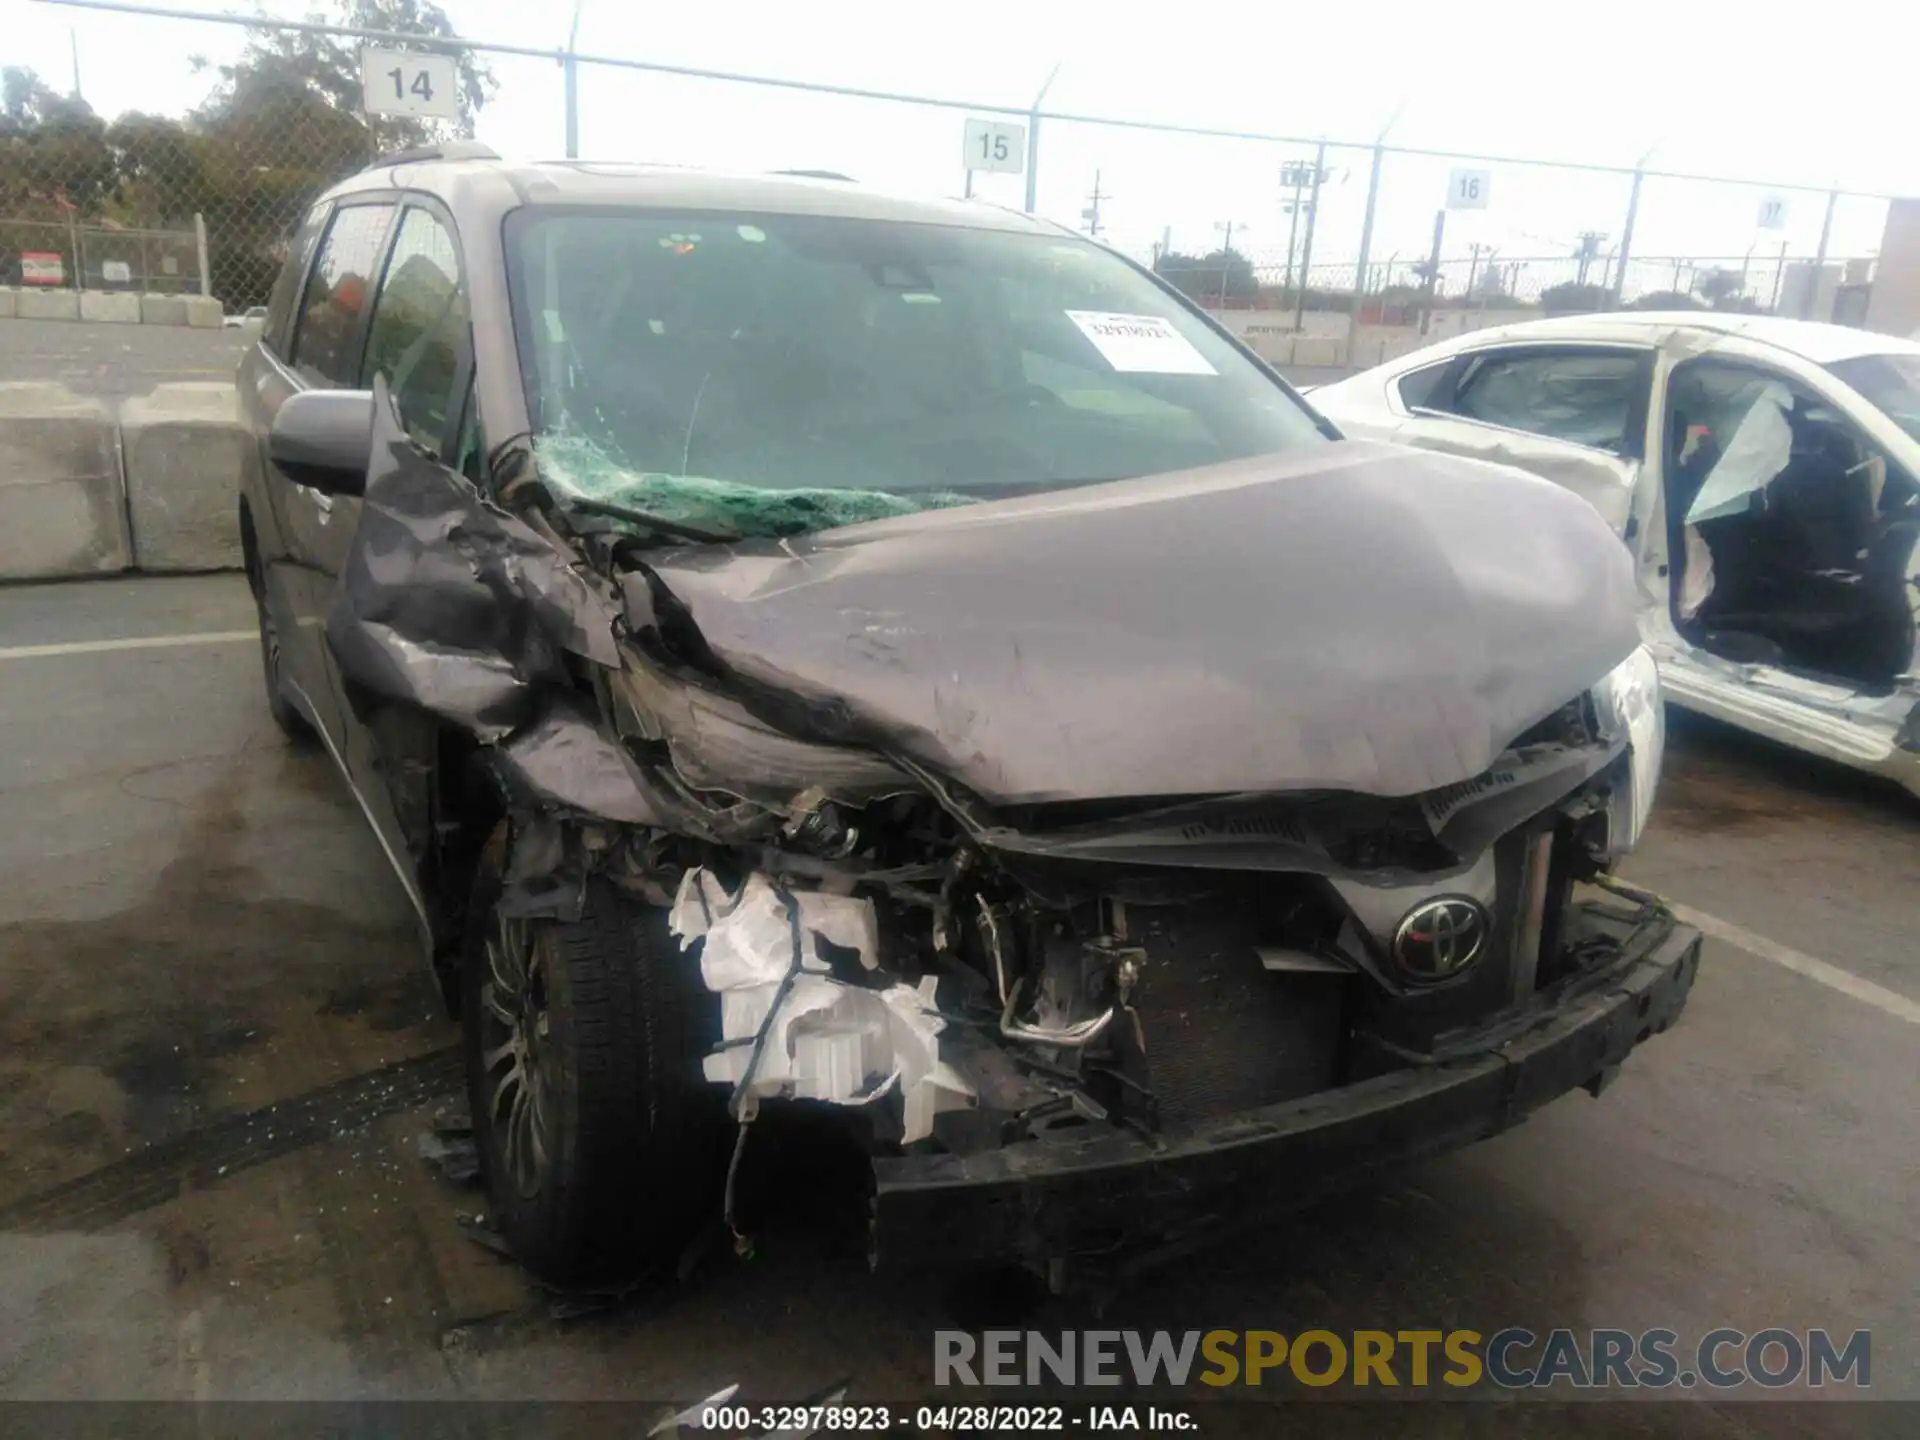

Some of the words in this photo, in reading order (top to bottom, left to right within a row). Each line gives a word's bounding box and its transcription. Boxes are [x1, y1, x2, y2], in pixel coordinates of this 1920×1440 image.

[387, 67, 434, 101] 14
[979, 132, 1009, 161] 15
[1460, 175, 1480, 200] 16
